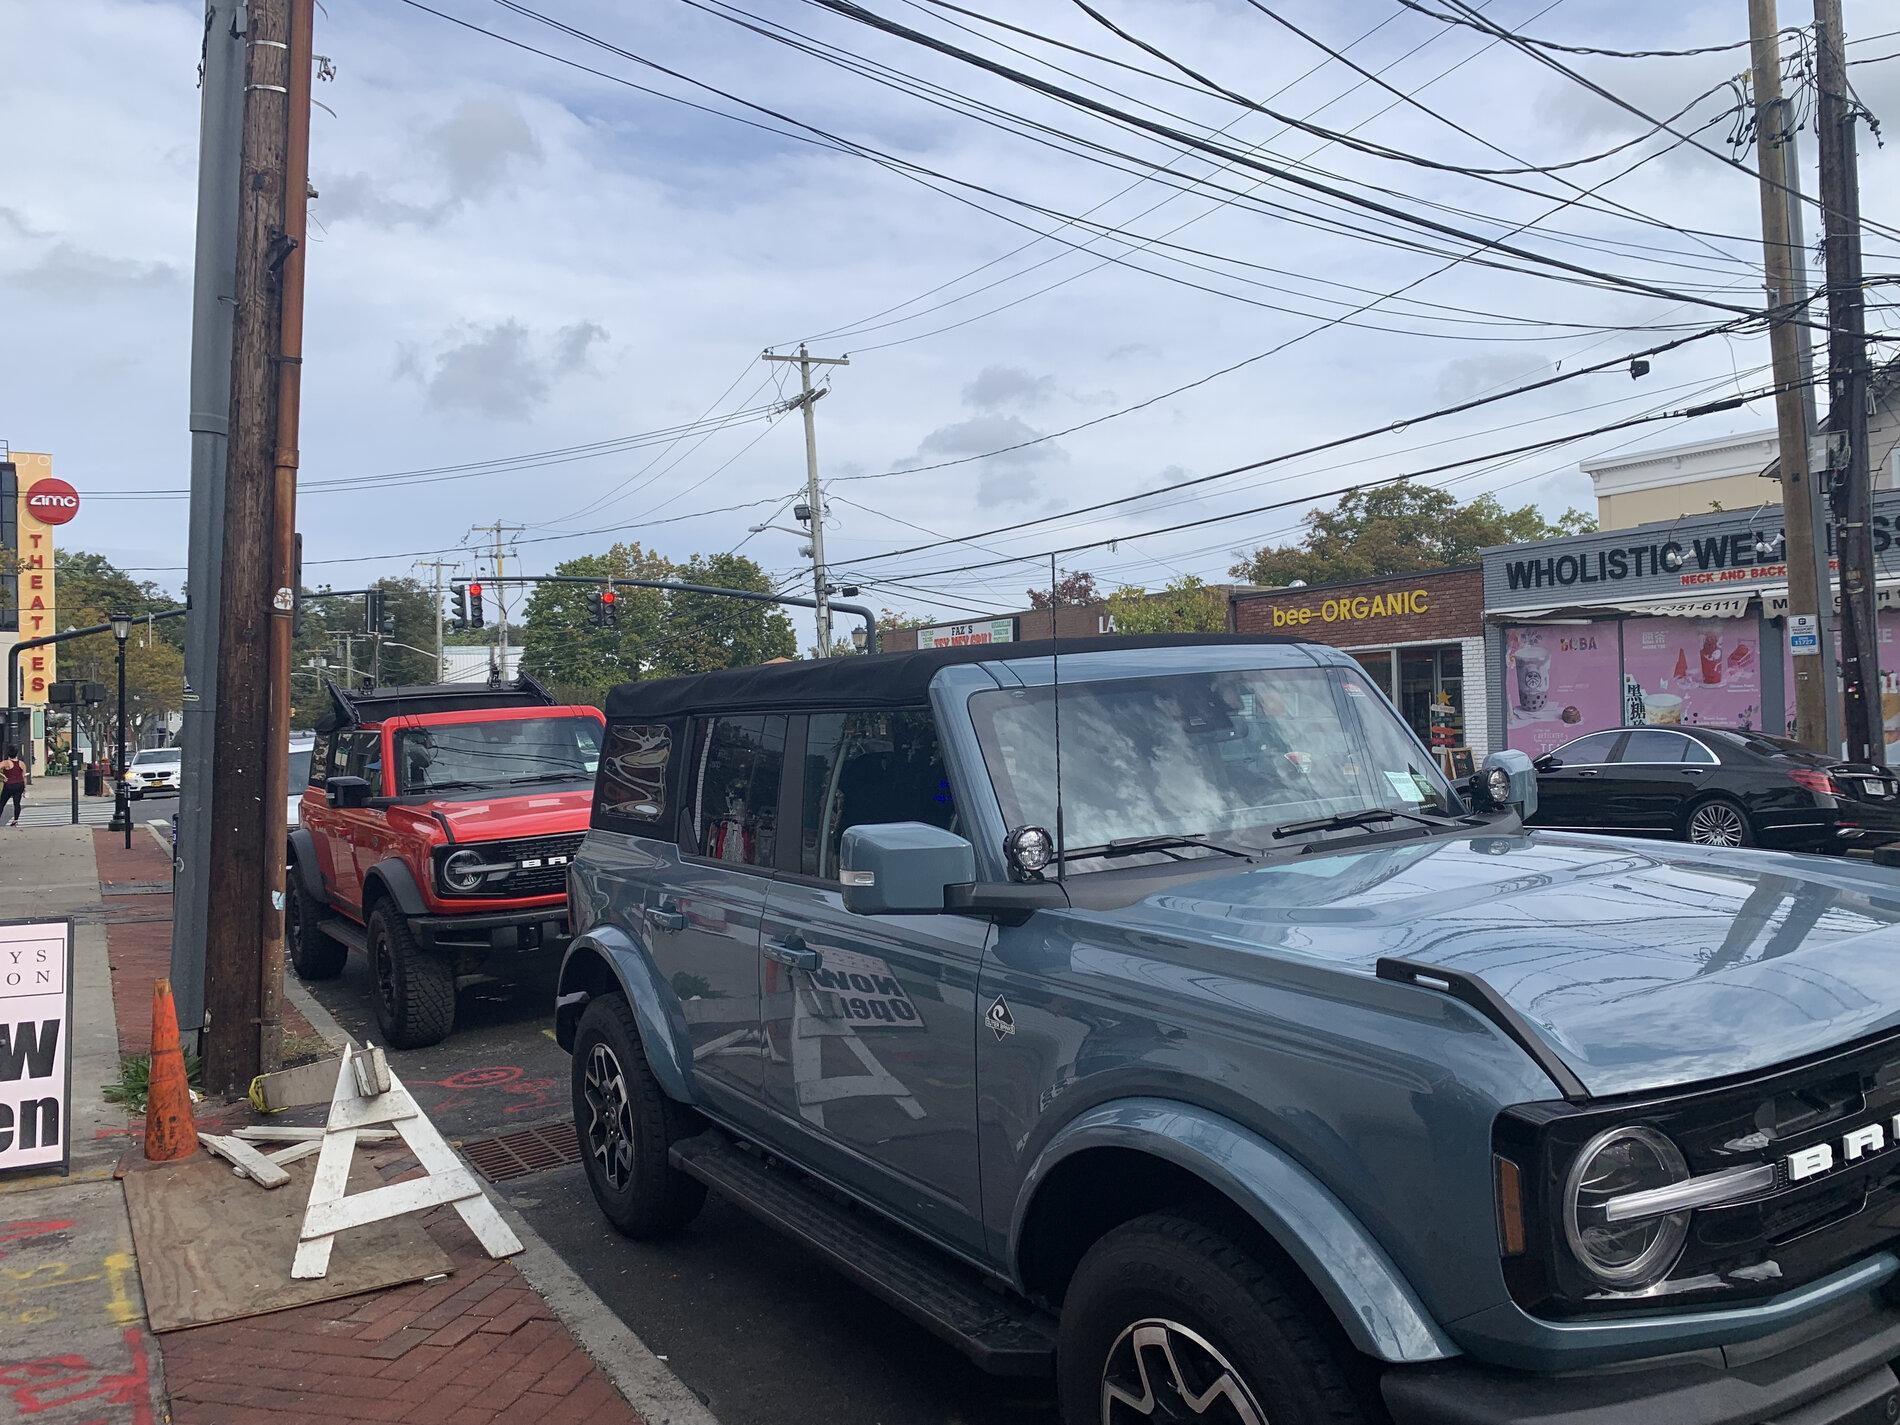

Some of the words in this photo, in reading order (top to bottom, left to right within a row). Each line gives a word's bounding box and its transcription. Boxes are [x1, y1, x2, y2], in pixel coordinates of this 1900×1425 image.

[1506, 541, 1683, 590] WHOLISTIC
[1681, 572, 1714, 585] NECK
[1720, 569, 1746, 582] AND
[1750, 565, 1787, 579] BACK
[1273, 589, 1428, 627] bee-ORGANIC
